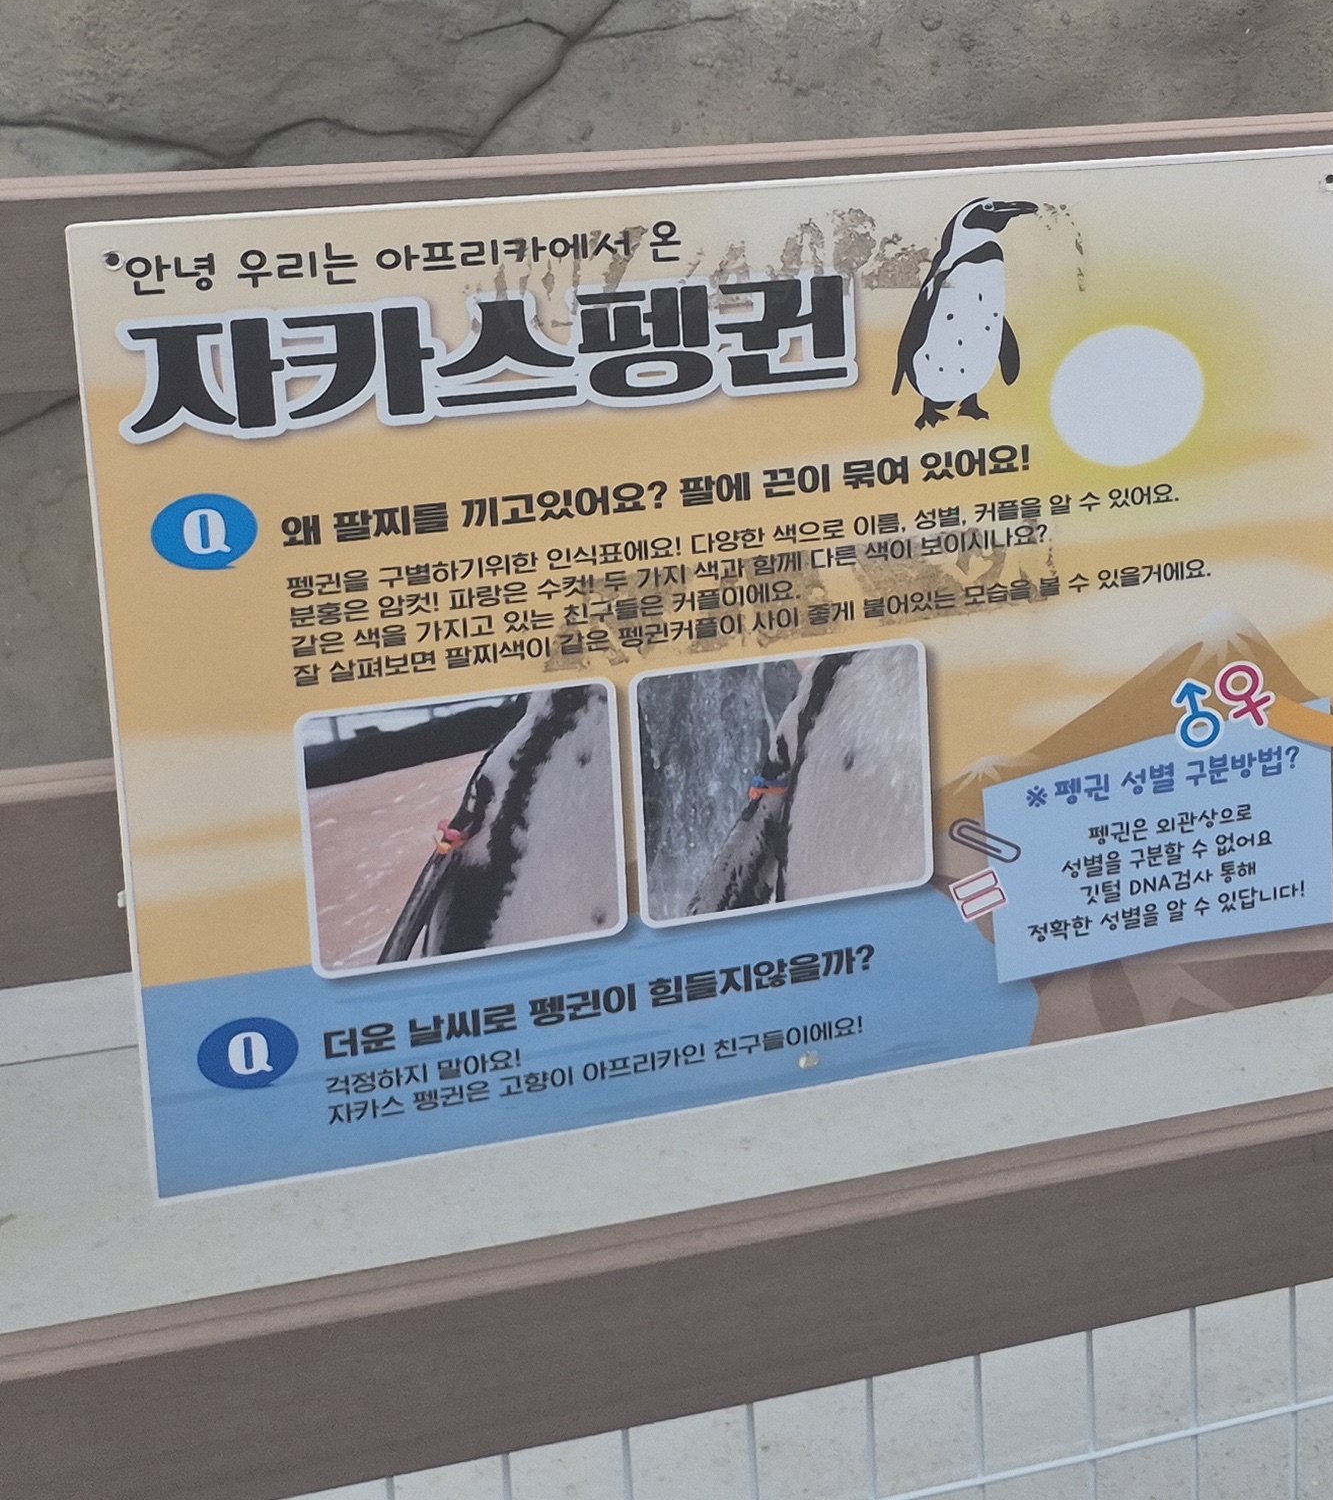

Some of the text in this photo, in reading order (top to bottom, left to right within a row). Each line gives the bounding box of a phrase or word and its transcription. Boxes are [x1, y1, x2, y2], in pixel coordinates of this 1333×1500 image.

[125, 220, 682, 296] 안녕 우리는 아프리카에서 온
[124, 272, 851, 436] 자카스펭귄
[182, 507, 232, 555] Q
[281, 444, 1030, 547] 왜 팔찌를 끼고있어요? 팔에 끈이 묶여 있어요!
[286, 483, 1180, 599] 펭귄을 구별하기위한 인식표에요! 다양한 색으로 이름, 성별, 커플을 알 수 있어요.
[289, 523, 1049, 628] 분홍은 암컷! 파랑은 수컷! 두 가지 색과 함께 다른 색이 보이시나요?
[291, 580, 801, 658] 같은 색을 가지고 있는 친구들은 커플이에요.
[293, 663, 321, 687] 잘
[329, 649, 437, 683] 살펴보면
[445, 637, 551, 670] 팔찌색이
[560, 628, 609, 655] 같은
[617, 613, 743, 649] 펭귄커플이
[752, 607, 800, 632] 사이
[807, 599, 855, 625] 좋게
[964, 578, 1032, 606] 모습을
[1039, 574, 1061, 598] 볼
[1068, 571, 1090, 593] 수
[1097, 558, 1212, 591] 있을거에요.
[1053, 773, 1110, 805] 펭귄
[1120, 761, 1176, 795] 성별
[1185, 745, 1301, 787] 구분방법?
[1061, 829, 1273, 879] 성별을 구분할 수 없어요
[1087, 803, 1252, 845] 펭귄은 외관상으로
[1027, 880, 1305, 943] 정확한 성별을 알 수 있답니다!
[1080, 861, 1257, 905] 깃털 DNA검사 통해
[323, 943, 876, 1059] 더운 날씨로 펭귄이 힘들지않을까?
[228, 1031, 274, 1076] Q
[325, 1047, 522, 1096] 걱정하지 말아요!
[328, 1015, 864, 1126] 자카스 펭귄은 고향이 아프리카인 친구들이에요!
